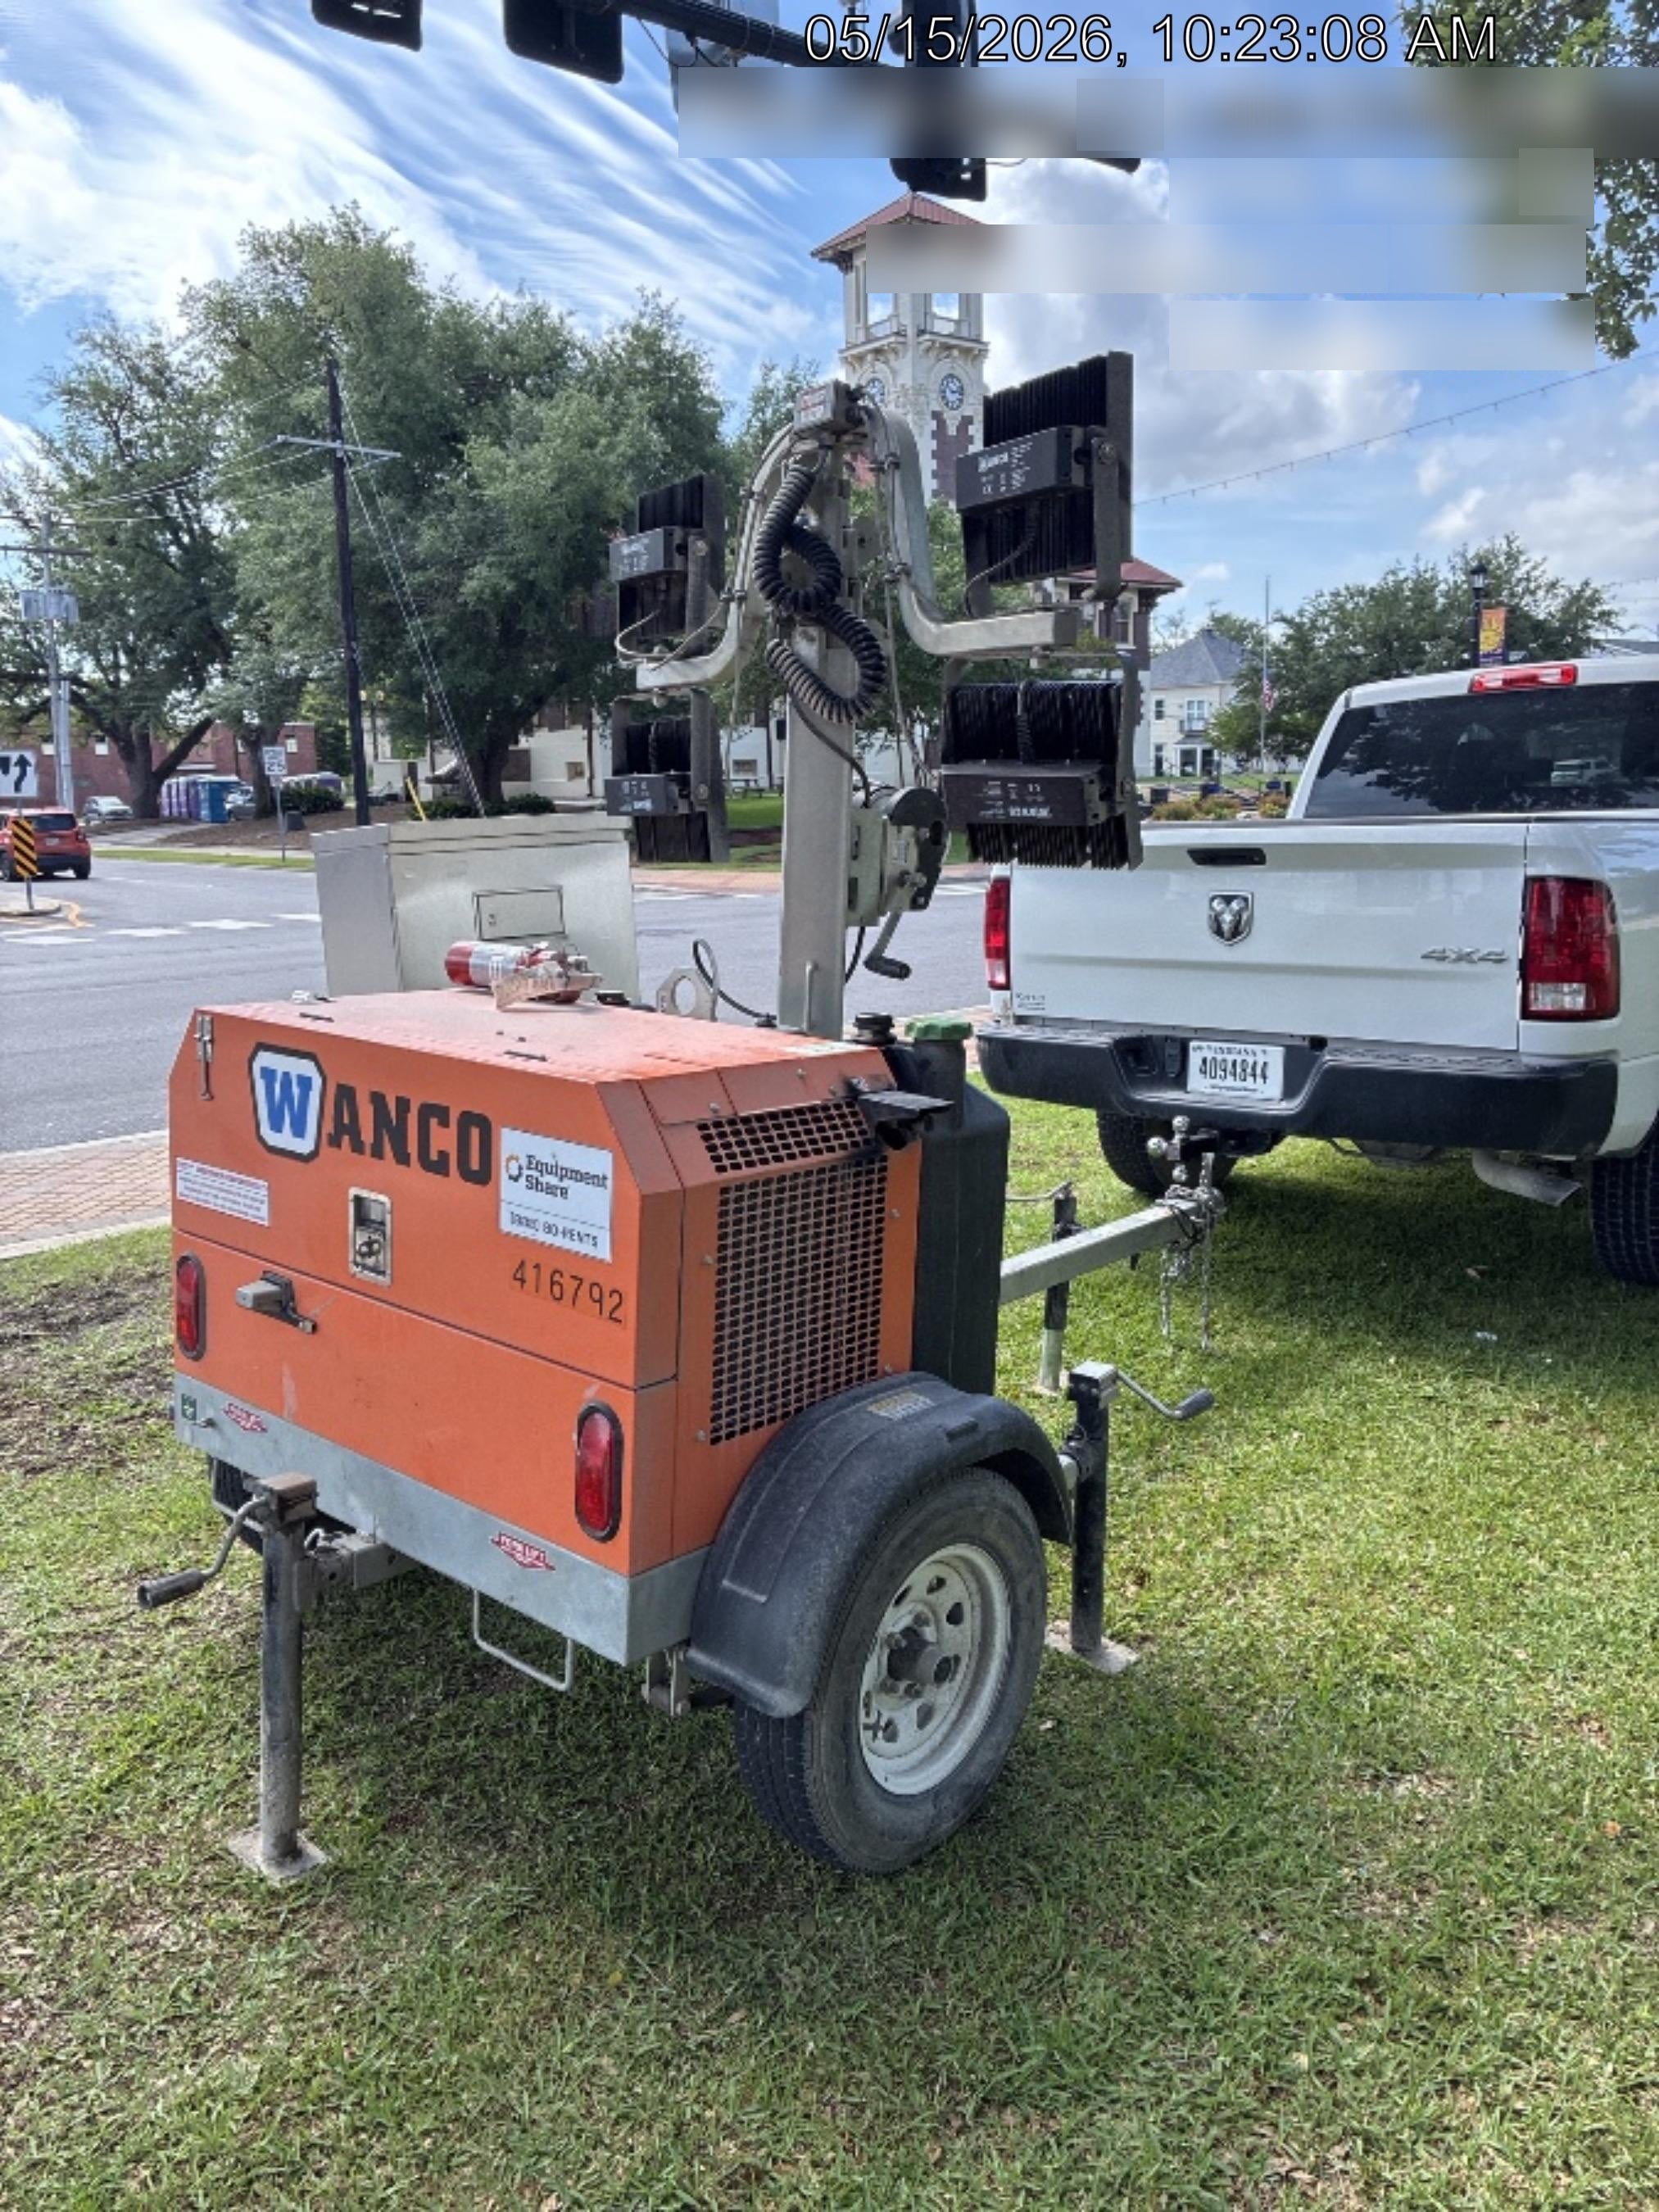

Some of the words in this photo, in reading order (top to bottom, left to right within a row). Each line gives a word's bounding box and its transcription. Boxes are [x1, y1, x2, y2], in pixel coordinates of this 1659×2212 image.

[1199, 1056, 1269, 1086] 4094844
[260, 1066, 492, 1186] WANCO
[525, 1154, 608, 1190] Equipment
[525, 1174, 569, 1200] Share
[512, 1259, 623, 1324] 416792
